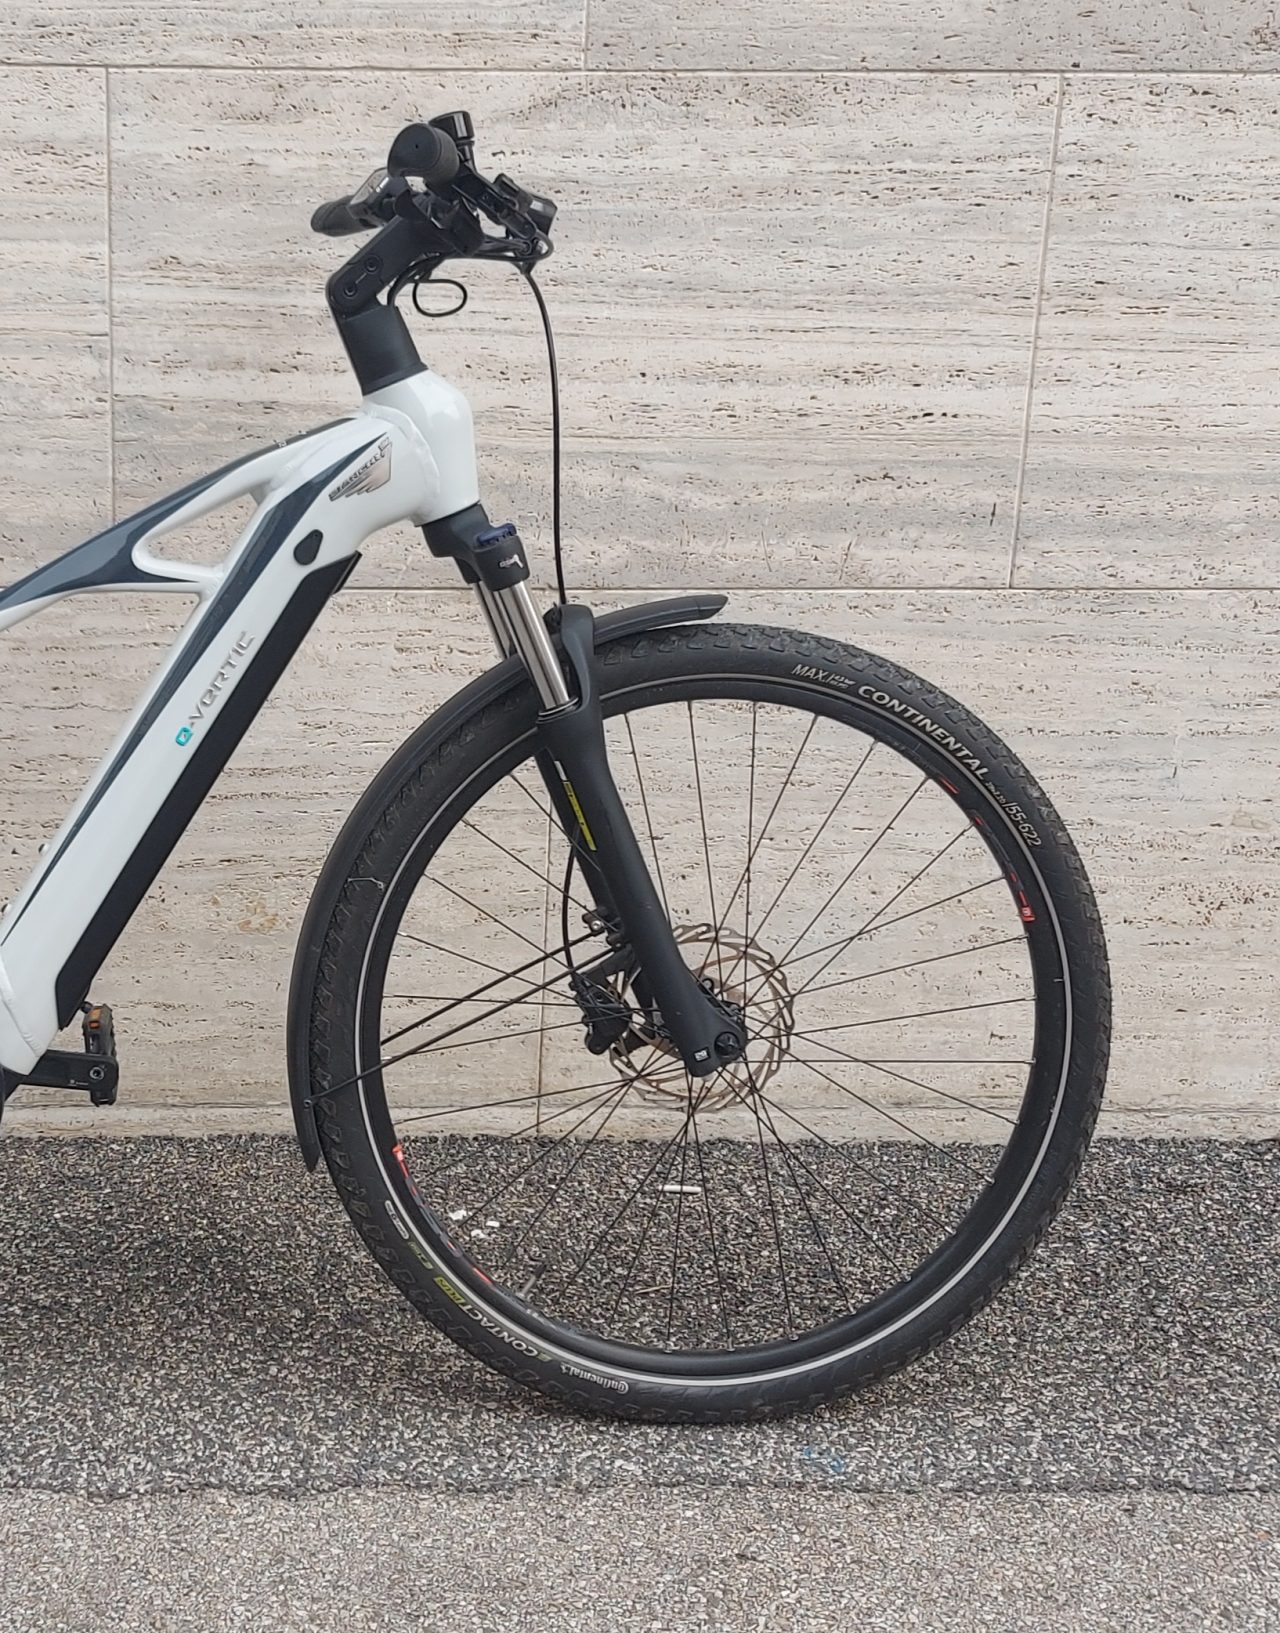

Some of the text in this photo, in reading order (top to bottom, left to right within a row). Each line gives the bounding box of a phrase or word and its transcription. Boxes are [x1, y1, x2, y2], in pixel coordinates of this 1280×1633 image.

[858, 685, 989, 780] CONTINENTAL
[436, 1278, 466, 1304] PLUS
[569, 1368, 630, 1395] Continental
